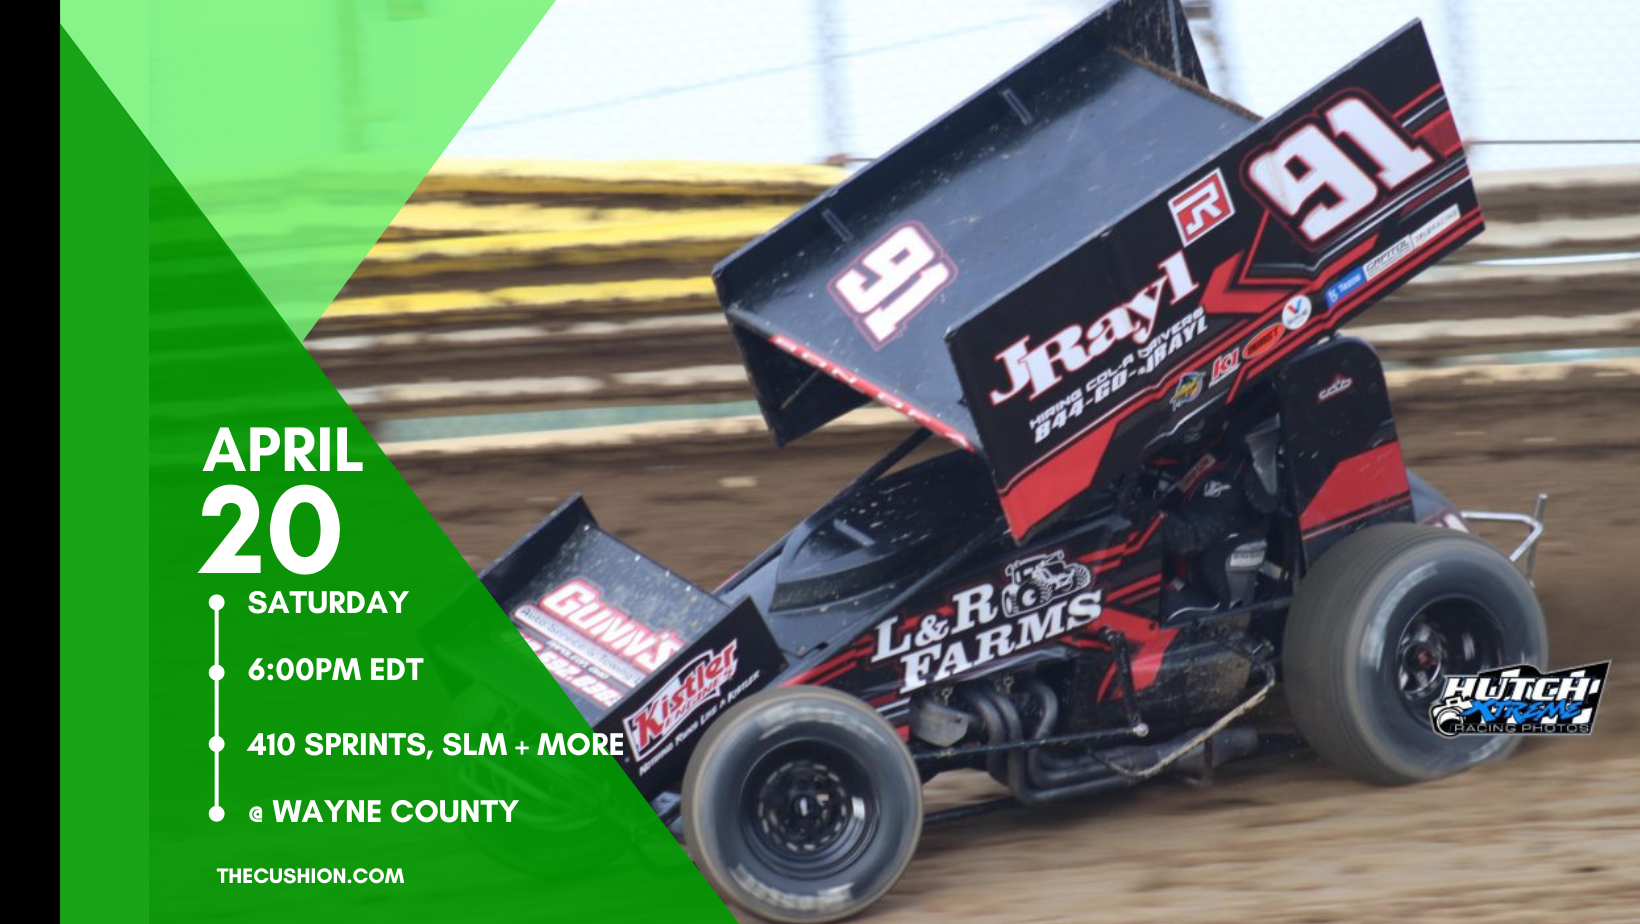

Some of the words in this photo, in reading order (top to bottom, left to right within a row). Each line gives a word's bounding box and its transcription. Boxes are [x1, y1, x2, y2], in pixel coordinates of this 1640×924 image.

[1248, 97, 1436, 242] 91
[833, 223, 952, 345] 91
[989, 249, 1200, 406] JRayl
[1029, 388, 1084, 430] HIRING
[1137, 306, 1205, 359] DRIVERS
[540, 579, 685, 673] GUNN'S
[871, 583, 999, 663] L&R
[900, 590, 1103, 695] FARMS
[634, 642, 736, 749] Kistler
